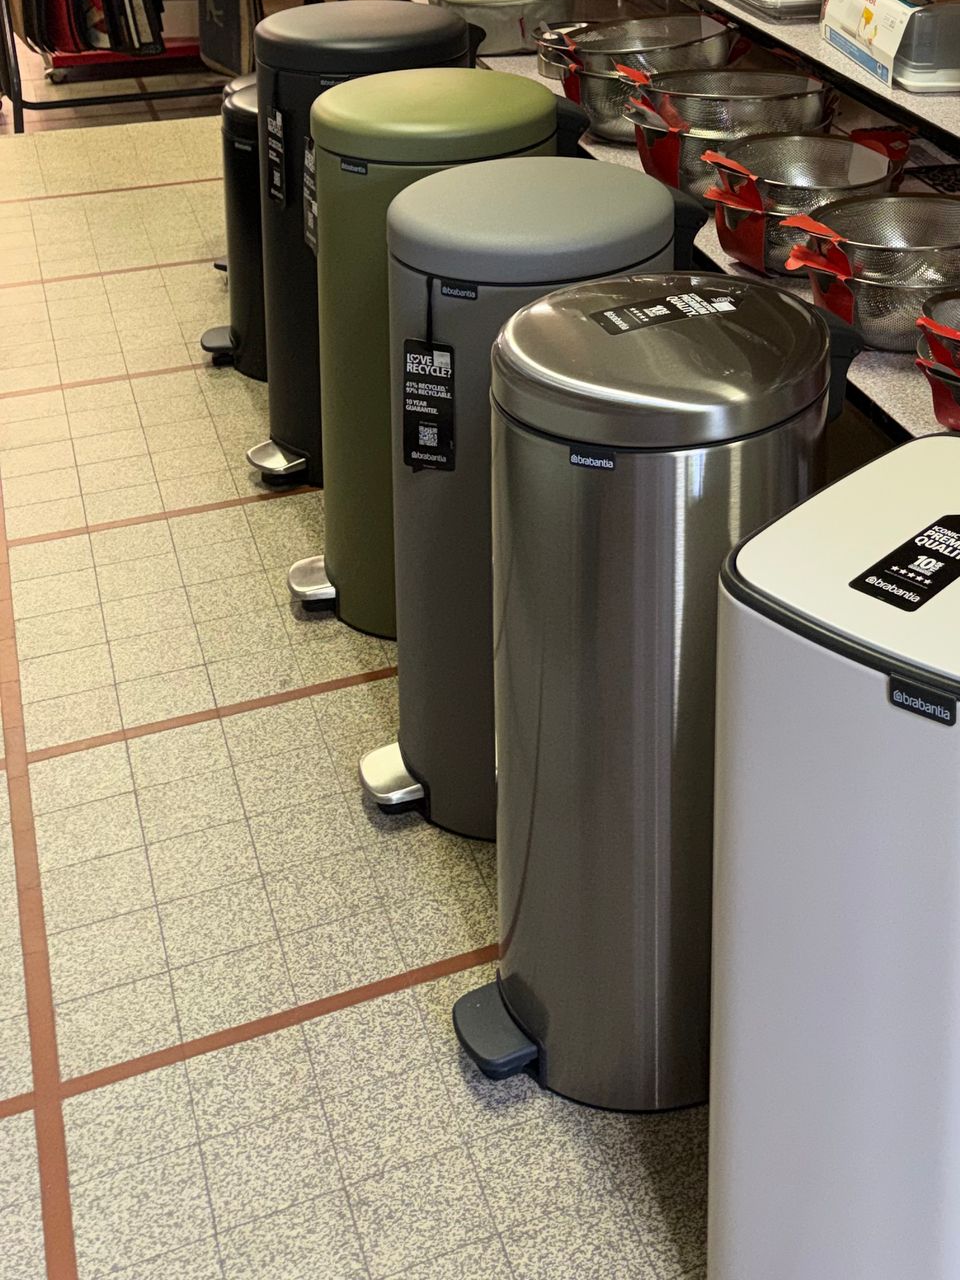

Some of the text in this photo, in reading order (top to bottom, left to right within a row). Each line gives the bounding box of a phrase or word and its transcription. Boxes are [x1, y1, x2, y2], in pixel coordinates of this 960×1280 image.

[406, 363, 452, 378] RECYCLE?
[577, 455, 614, 468] brabantia
[914, 555, 937, 570] 10
[873, 577, 921, 603] brabantia
[902, 691, 951, 721] brabantia
